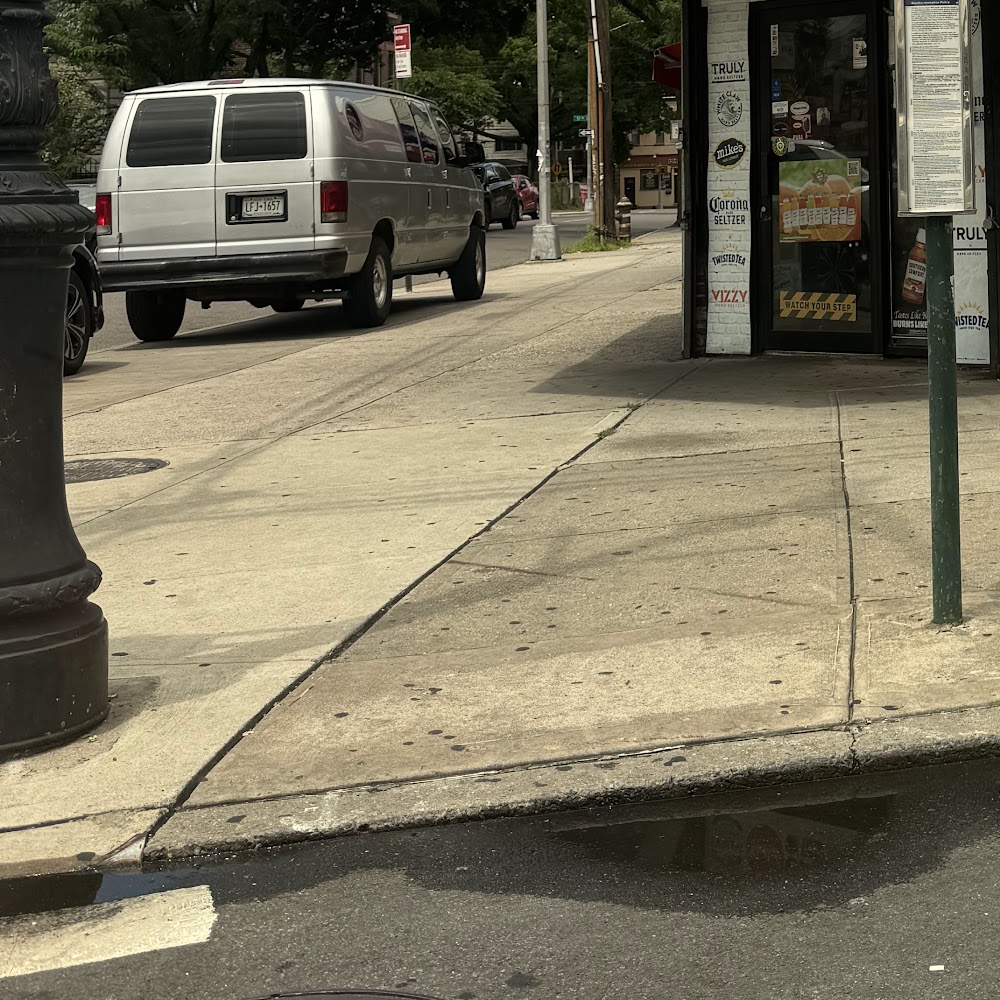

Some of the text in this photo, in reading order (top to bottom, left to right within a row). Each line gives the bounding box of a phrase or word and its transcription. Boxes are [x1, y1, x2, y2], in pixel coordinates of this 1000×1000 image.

[712, 61, 745, 75] TRULY
[716, 90, 741, 115] WHITE CLAW
[716, 142, 744, 160] mike's
[709, 196, 749, 213] Corona
[714, 215, 746, 225] SELTZER
[953, 226, 987, 241] RULY
[712, 253, 746, 267] TWISTED TEA
[711, 289, 747, 302] VIZZY
[785, 301, 851, 312] WATCH YOUR STEP
[955, 315, 977, 326] ISTED
